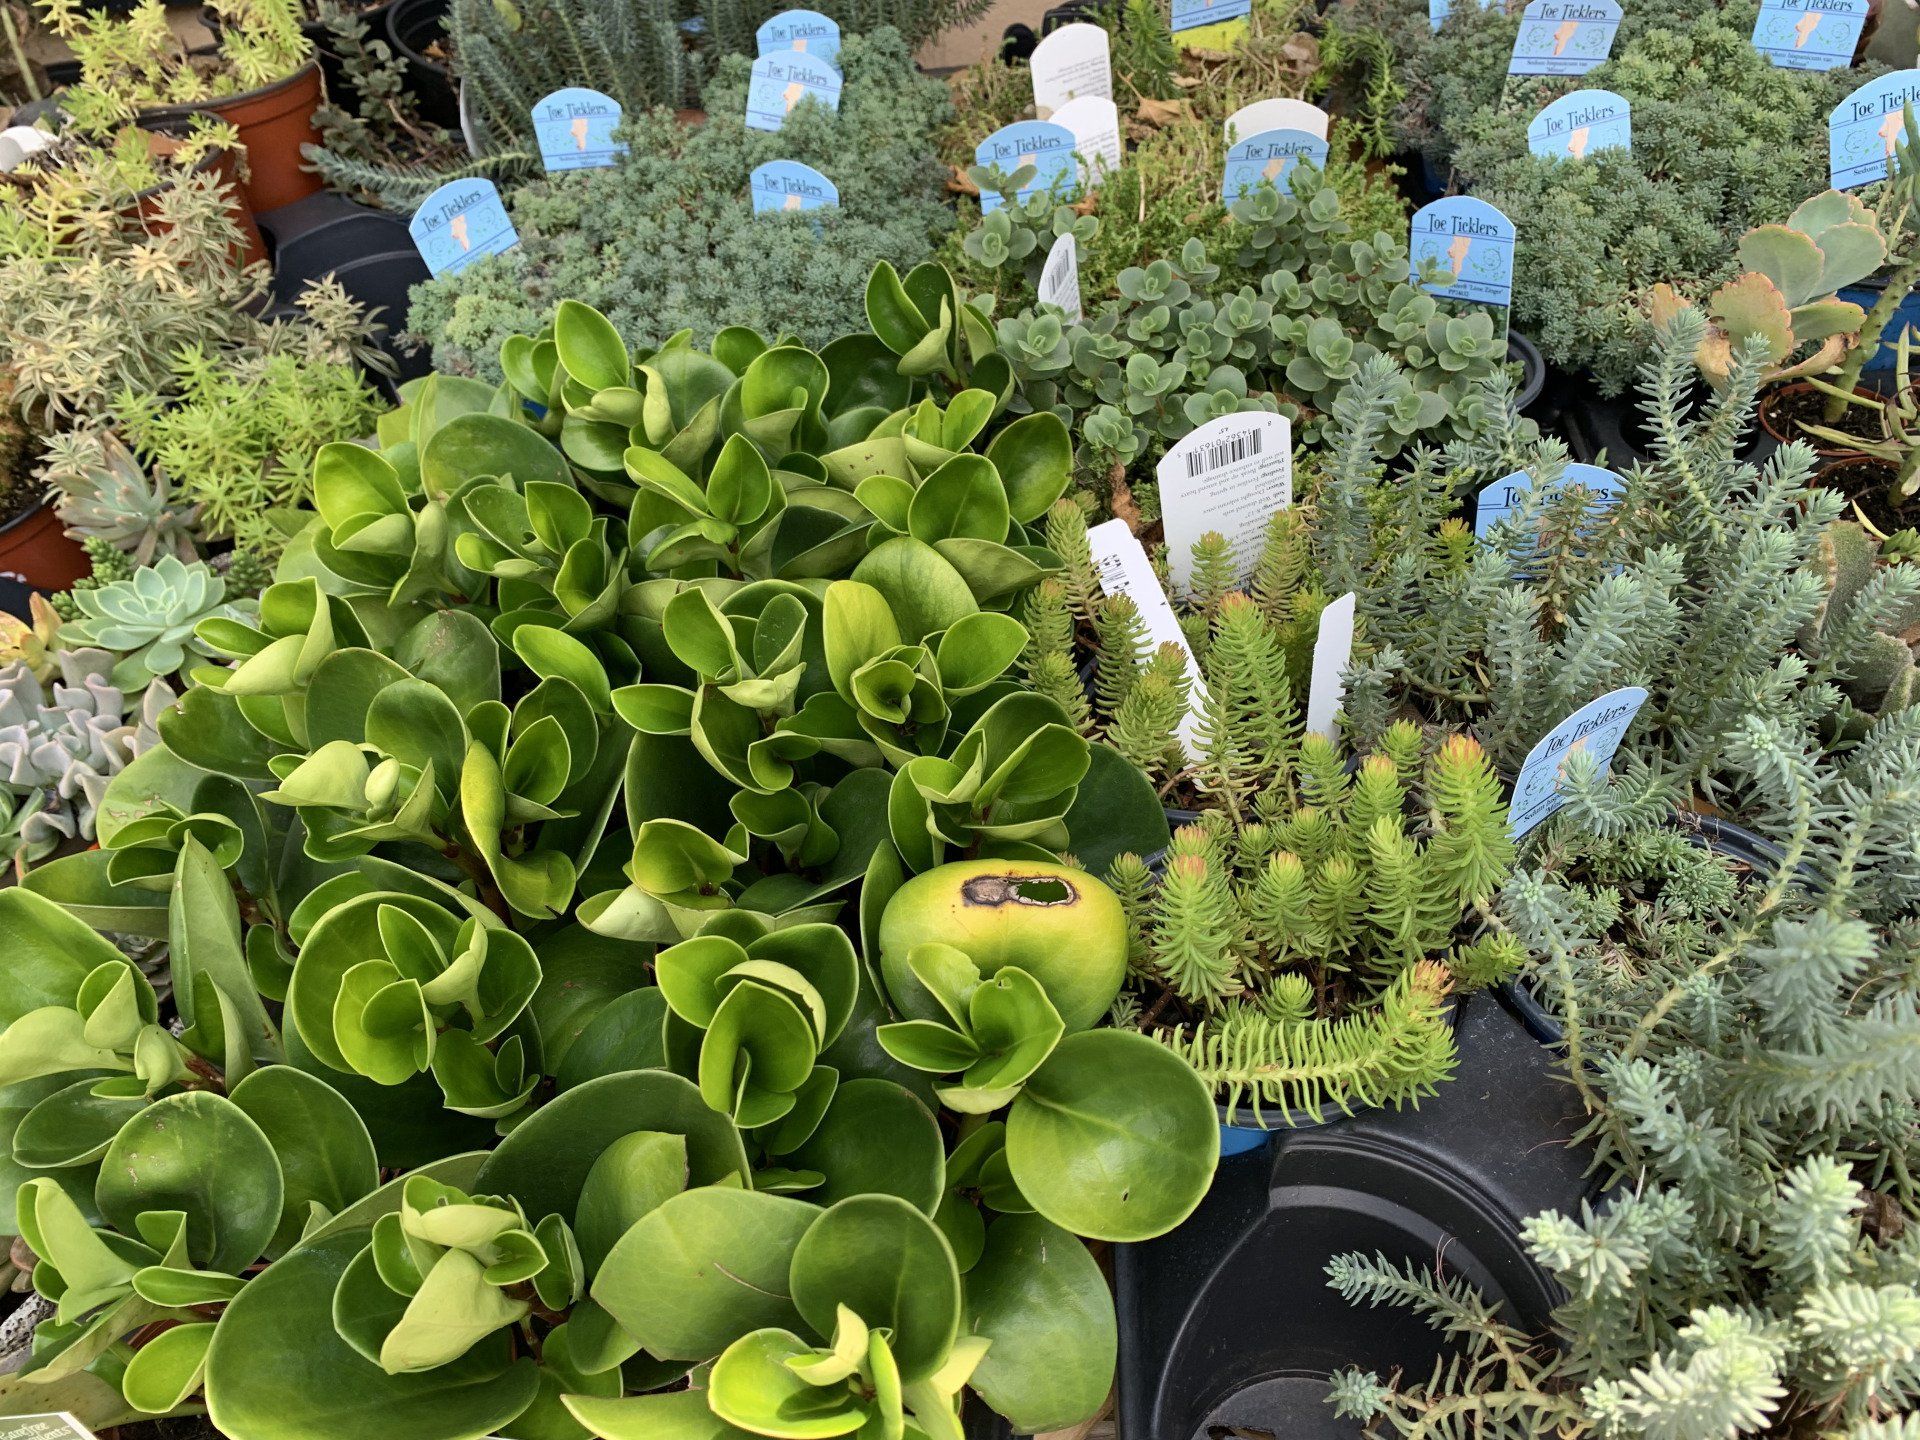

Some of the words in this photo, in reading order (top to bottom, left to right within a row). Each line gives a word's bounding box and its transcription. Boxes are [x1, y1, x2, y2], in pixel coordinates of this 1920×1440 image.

[1540, 2, 1560, 19] Toe
[1561, 3, 1608, 20] Ticklers
[770, 25, 787, 42] Toe
[789, 23, 828, 40] Ticklers
[766, 61, 784, 78] Toe
[787, 65, 828, 86] Ticklers
[545, 105, 563, 121] Toe
[565, 101, 608, 119] Ticklers
[1851, 101, 1875, 121] Toe
[1880, 85, 1920, 113] Tickle
[1543, 117, 1564, 136] Toe
[1566, 105, 1615, 130] Ticklers
[992, 142, 1012, 160] Toe
[1014, 135, 1061, 157] Ticklers
[1245, 144, 1264, 160] Toe
[1267, 142, 1314, 159] Ticklers
[761, 173, 779, 191] Toe
[781, 176, 823, 197] Ticklers
[422, 214, 441, 233] Toe
[440, 190, 481, 221] Ticklers
[1428, 213, 1447, 233] Toe
[1451, 215, 1499, 236] Ticklers
[1226, 428, 1251, 443] 14362
[1544, 733, 1569, 758] Toe
[1571, 703, 1629, 742] Ticklers
